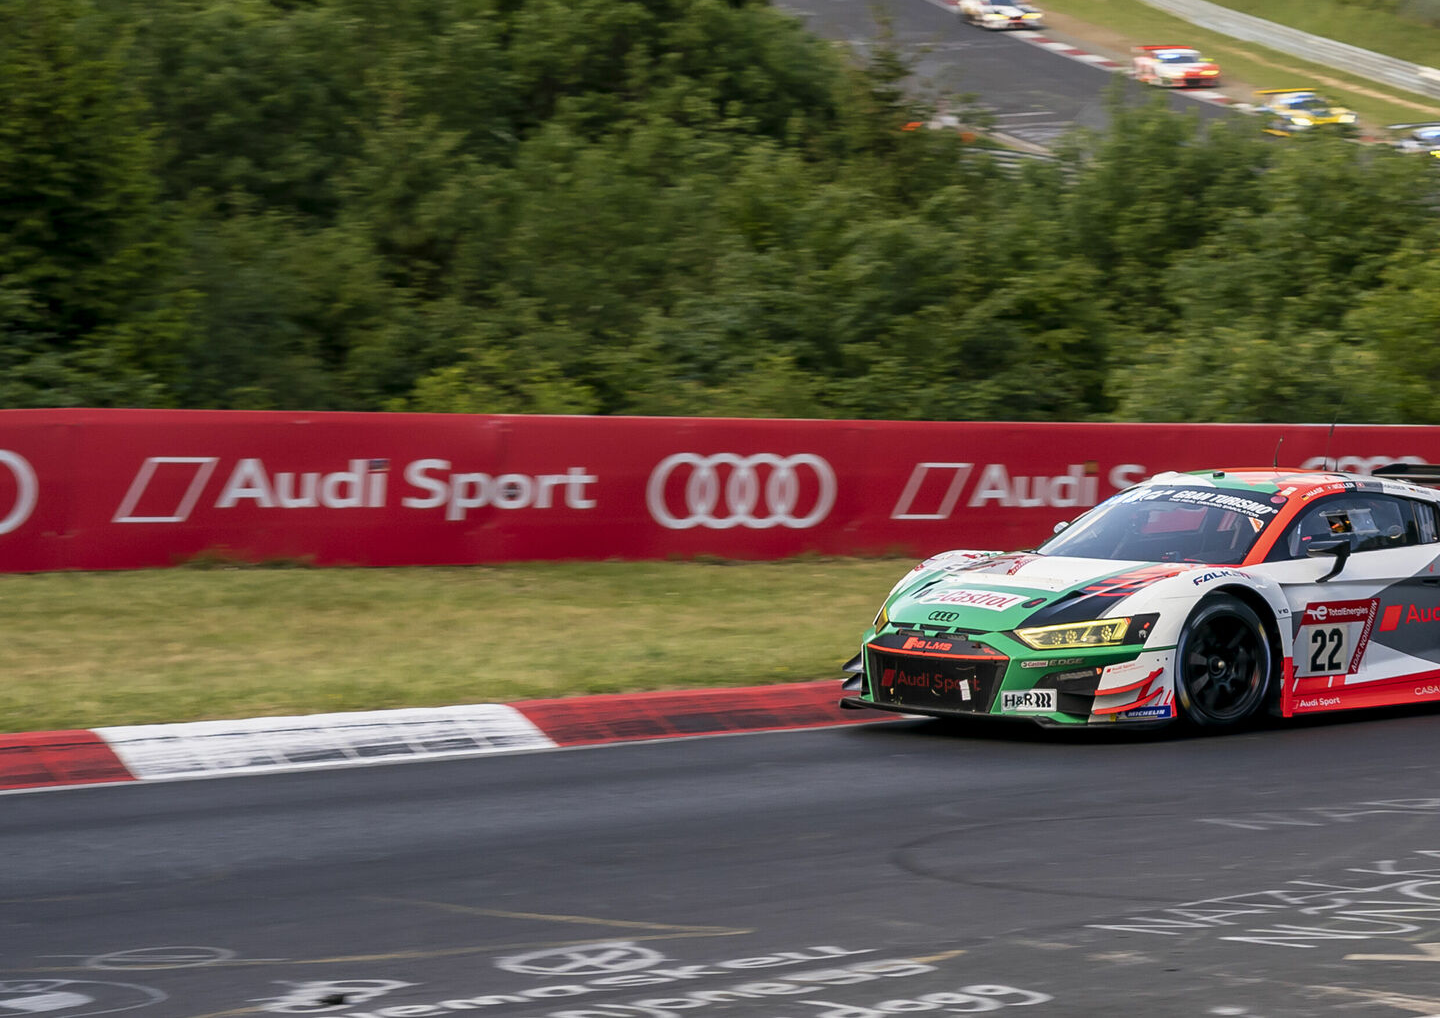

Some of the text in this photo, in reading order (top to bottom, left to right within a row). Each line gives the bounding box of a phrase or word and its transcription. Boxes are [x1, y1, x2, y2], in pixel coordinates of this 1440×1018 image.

[216, 457, 598, 521] Audi Sport
[967, 462, 1099, 507] Audi
[939, 590, 1018, 608] Castrol
[1328, 605, 1368, 617] TotalEnergies
[1310, 628, 1343, 673] 22
[1049, 657, 1086, 666] EDGE
[897, 670, 930, 688] Audi
[1004, 693, 1033, 708] H&R
[1300, 697, 1341, 708] Audi Sport
[1128, 709, 1165, 717] MICHELIN
